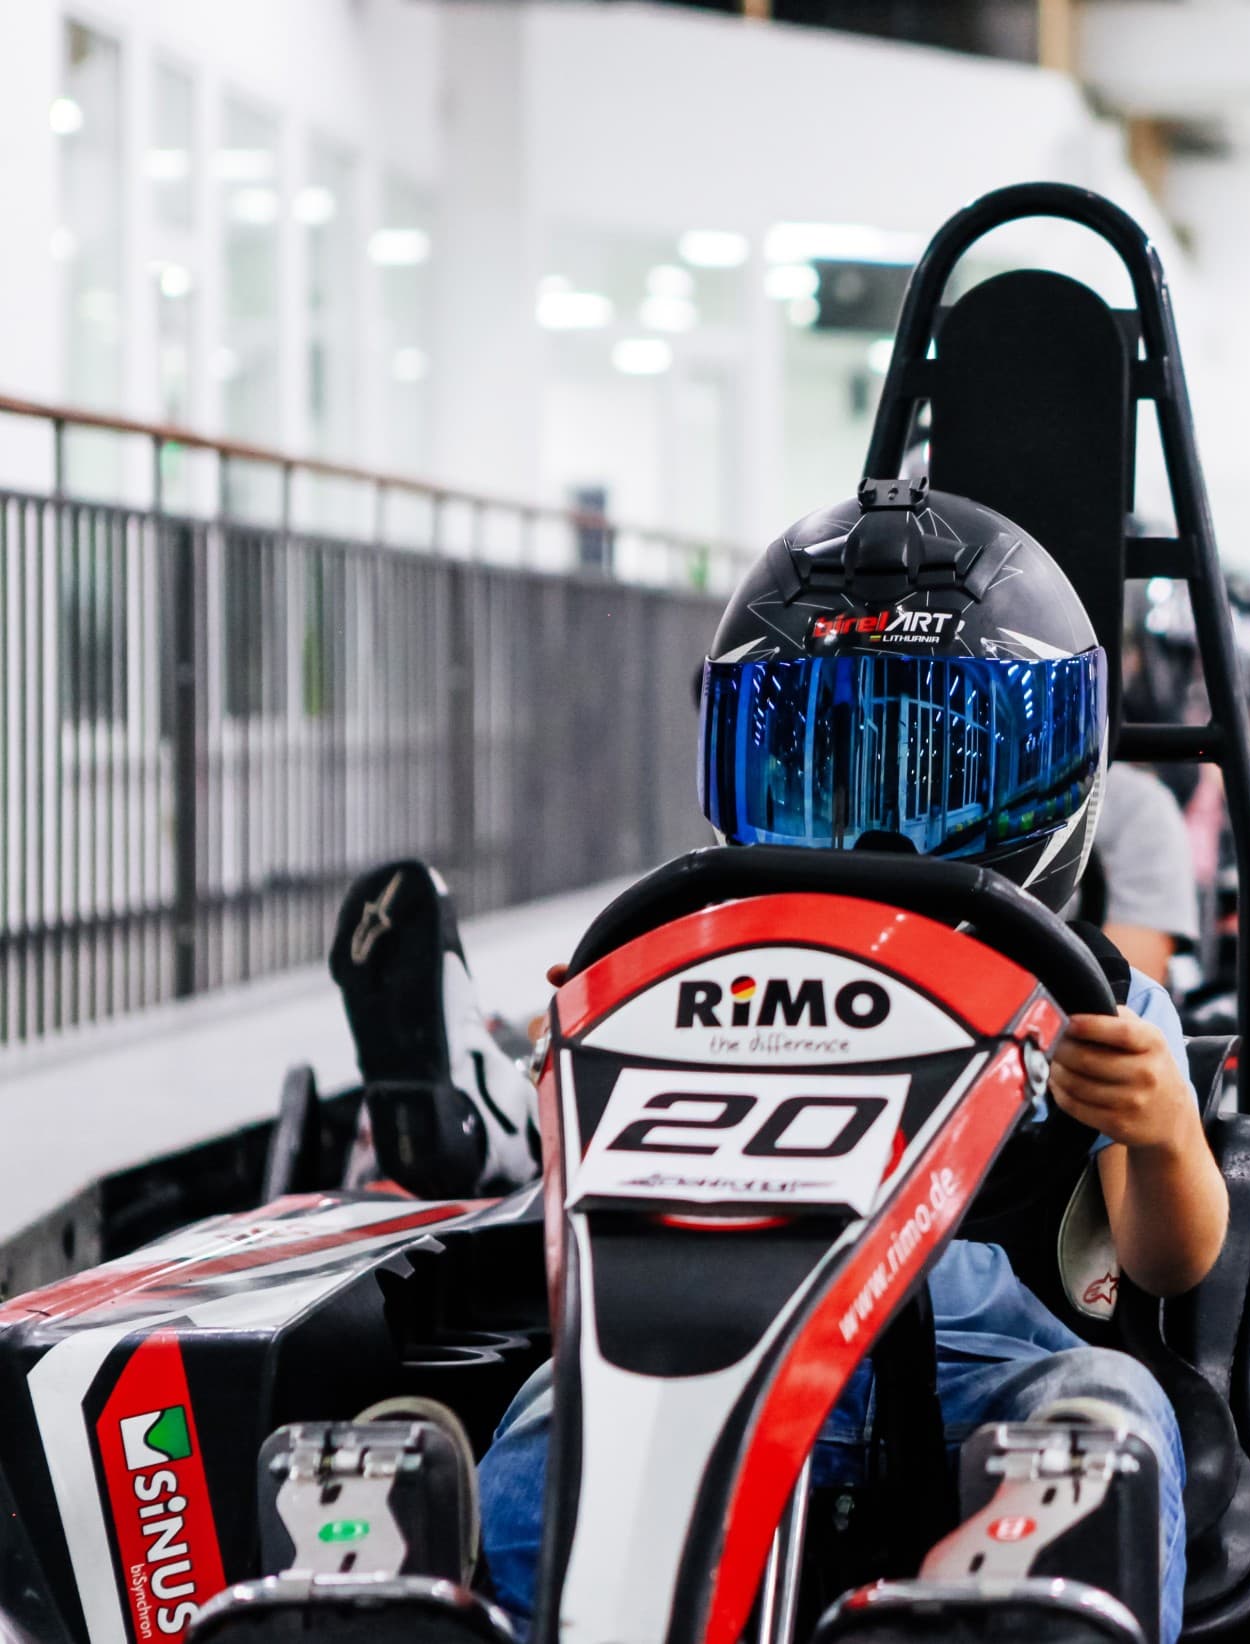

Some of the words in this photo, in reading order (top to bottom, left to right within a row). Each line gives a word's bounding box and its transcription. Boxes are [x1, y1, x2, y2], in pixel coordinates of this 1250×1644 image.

[882, 634, 941, 644] LITHUANIA
[710, 1034, 740, 1052] the
[749, 1030, 850, 1054] difference
[605, 1091, 889, 1159] 20
[838, 1167, 958, 1343] www.rimo.de
